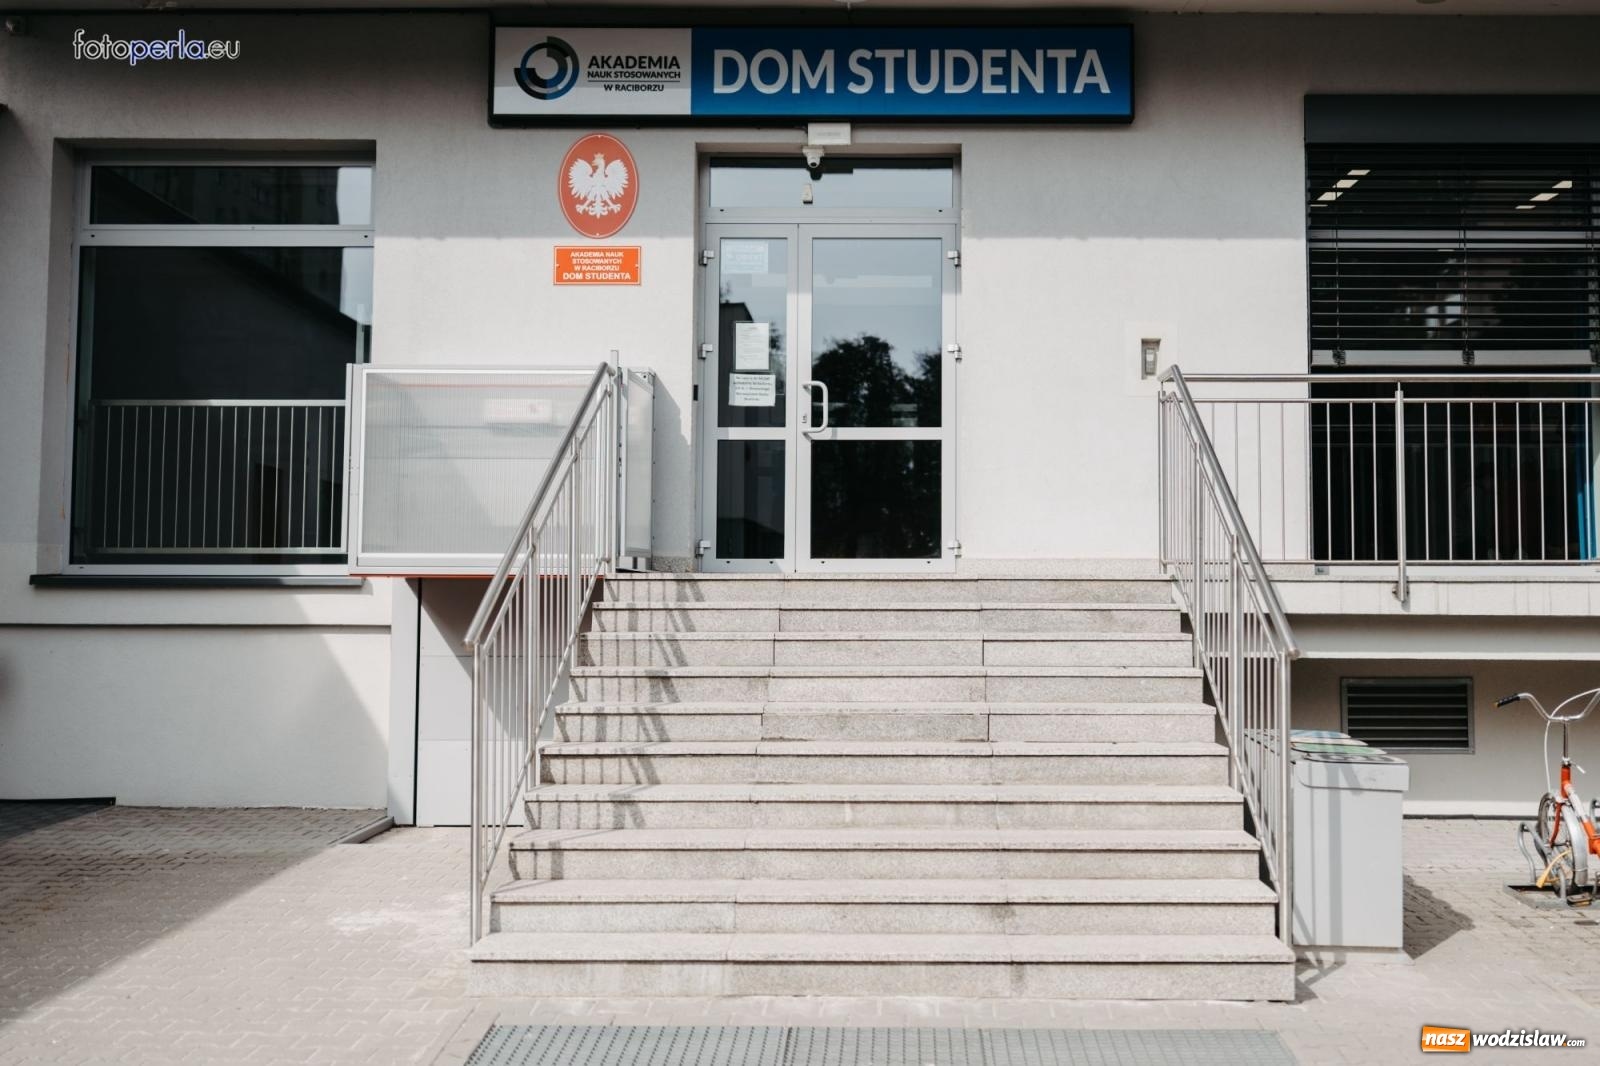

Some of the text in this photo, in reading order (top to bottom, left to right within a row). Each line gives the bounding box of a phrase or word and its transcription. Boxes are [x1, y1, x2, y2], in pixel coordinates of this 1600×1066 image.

[588, 55, 680, 69] AKADEMIA
[587, 70, 681, 79] NAUK STOSOWANYCH
[713, 49, 1111, 94] DOM STUDENTA
[603, 84, 664, 92] W RACIBORZU
[562, 272, 631, 280] DOM STUDENTA
